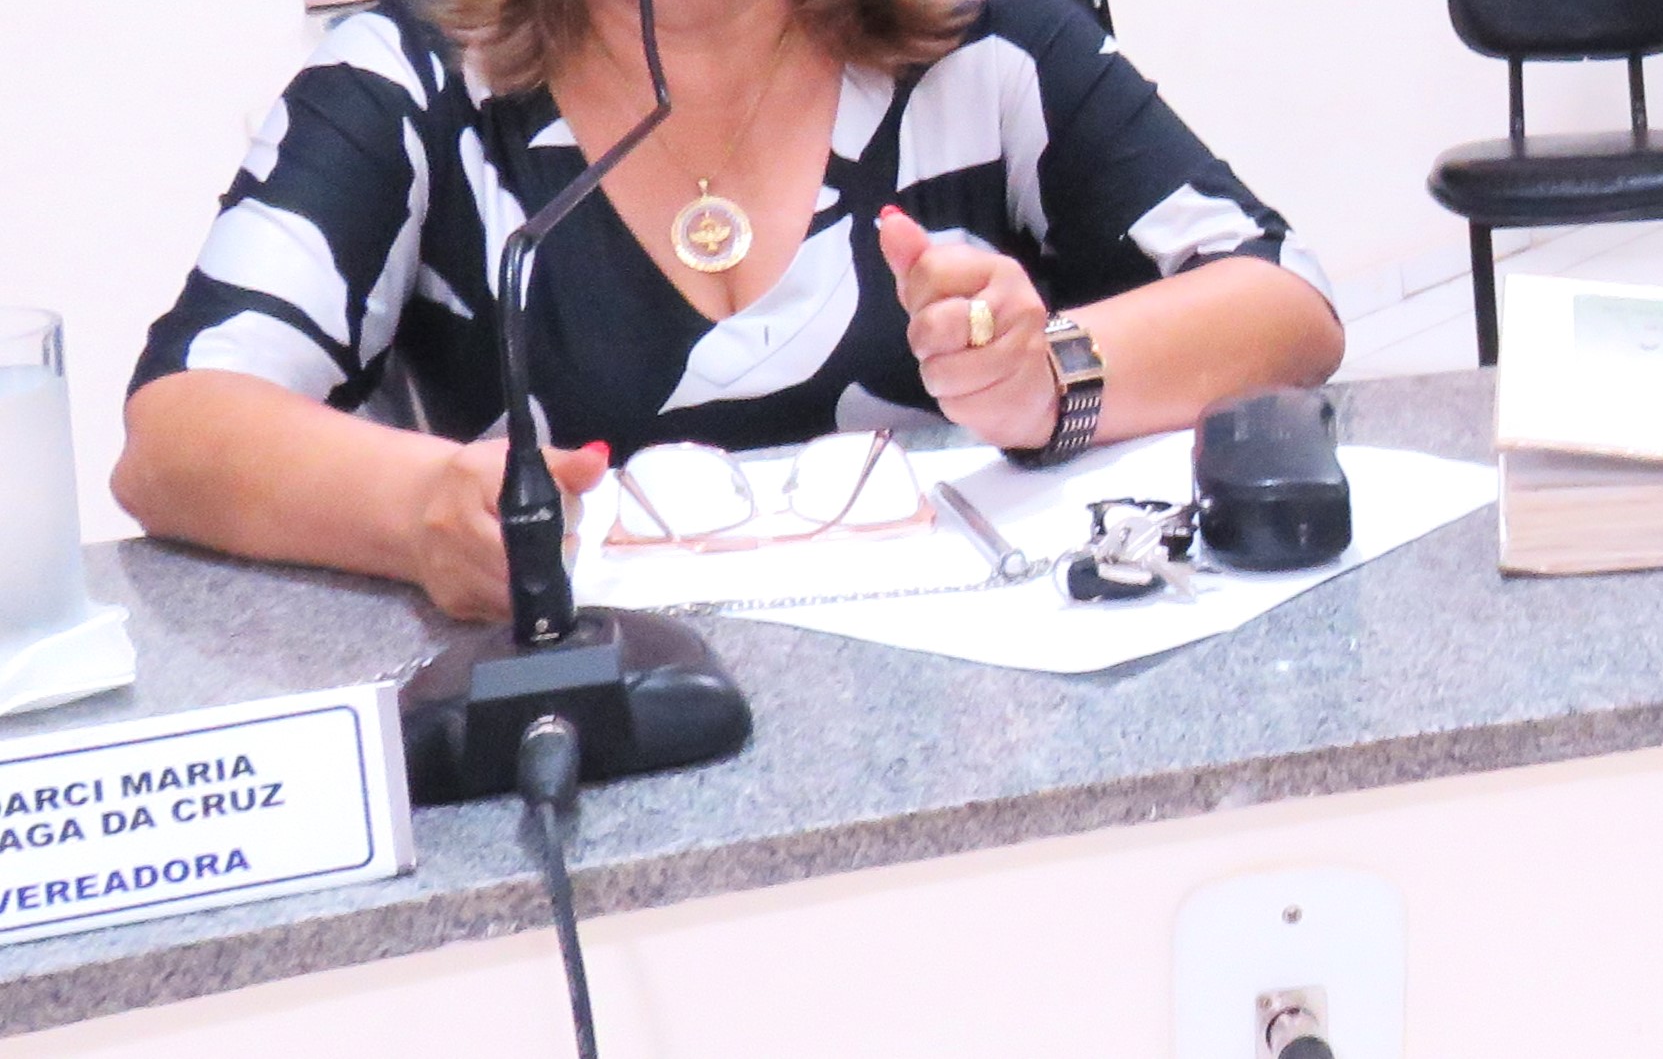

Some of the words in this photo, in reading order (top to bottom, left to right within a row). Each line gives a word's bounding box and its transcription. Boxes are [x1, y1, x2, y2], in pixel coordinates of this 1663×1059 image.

[0, 776, 104, 818] ARCI
[120, 754, 256, 798] MARIA
[100, 805, 157, 836] DA
[171, 781, 286, 824] CRUZ
